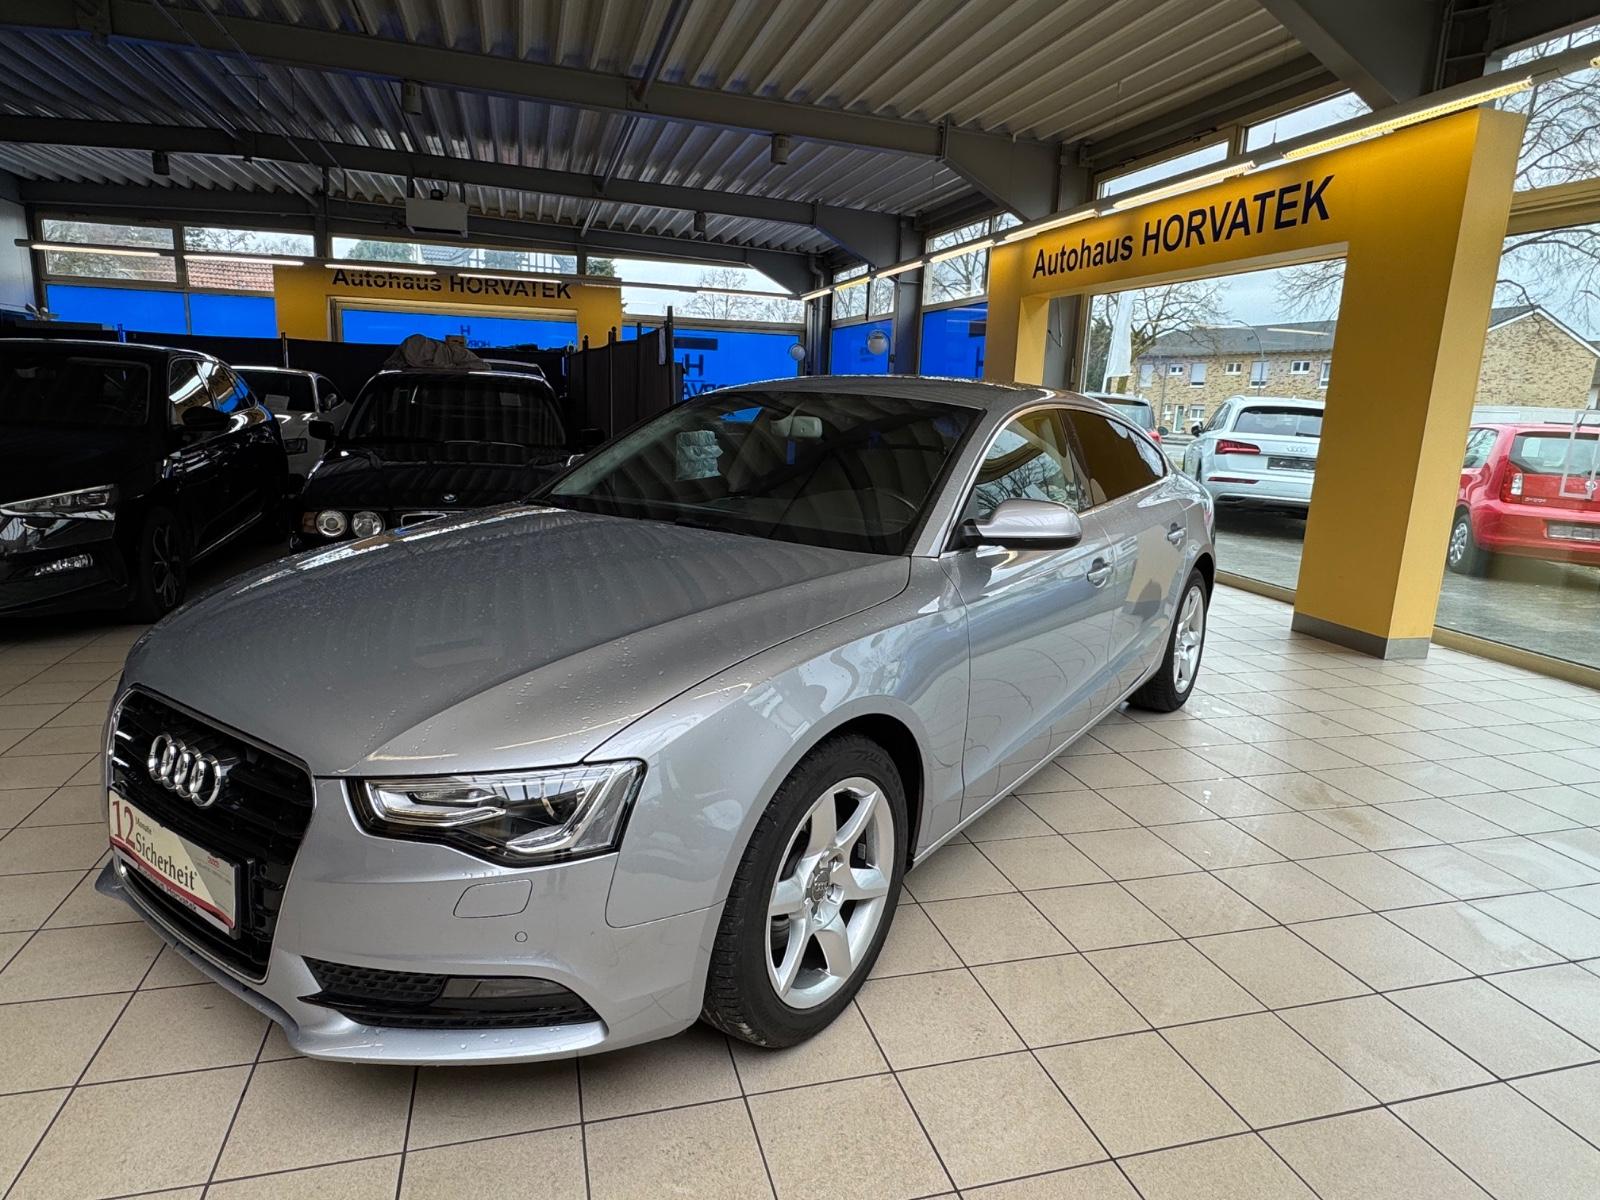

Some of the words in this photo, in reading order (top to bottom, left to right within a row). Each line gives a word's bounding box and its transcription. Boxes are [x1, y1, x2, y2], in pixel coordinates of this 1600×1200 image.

[1032, 235, 1133, 278] Autohaus
[1141, 175, 1335, 256] HORVATEK
[332, 268, 442, 292] Autohaus
[449, 275, 572, 299] HORVATEK
[112, 800, 136, 850] 12
[135, 832, 195, 891] Sicherheit
